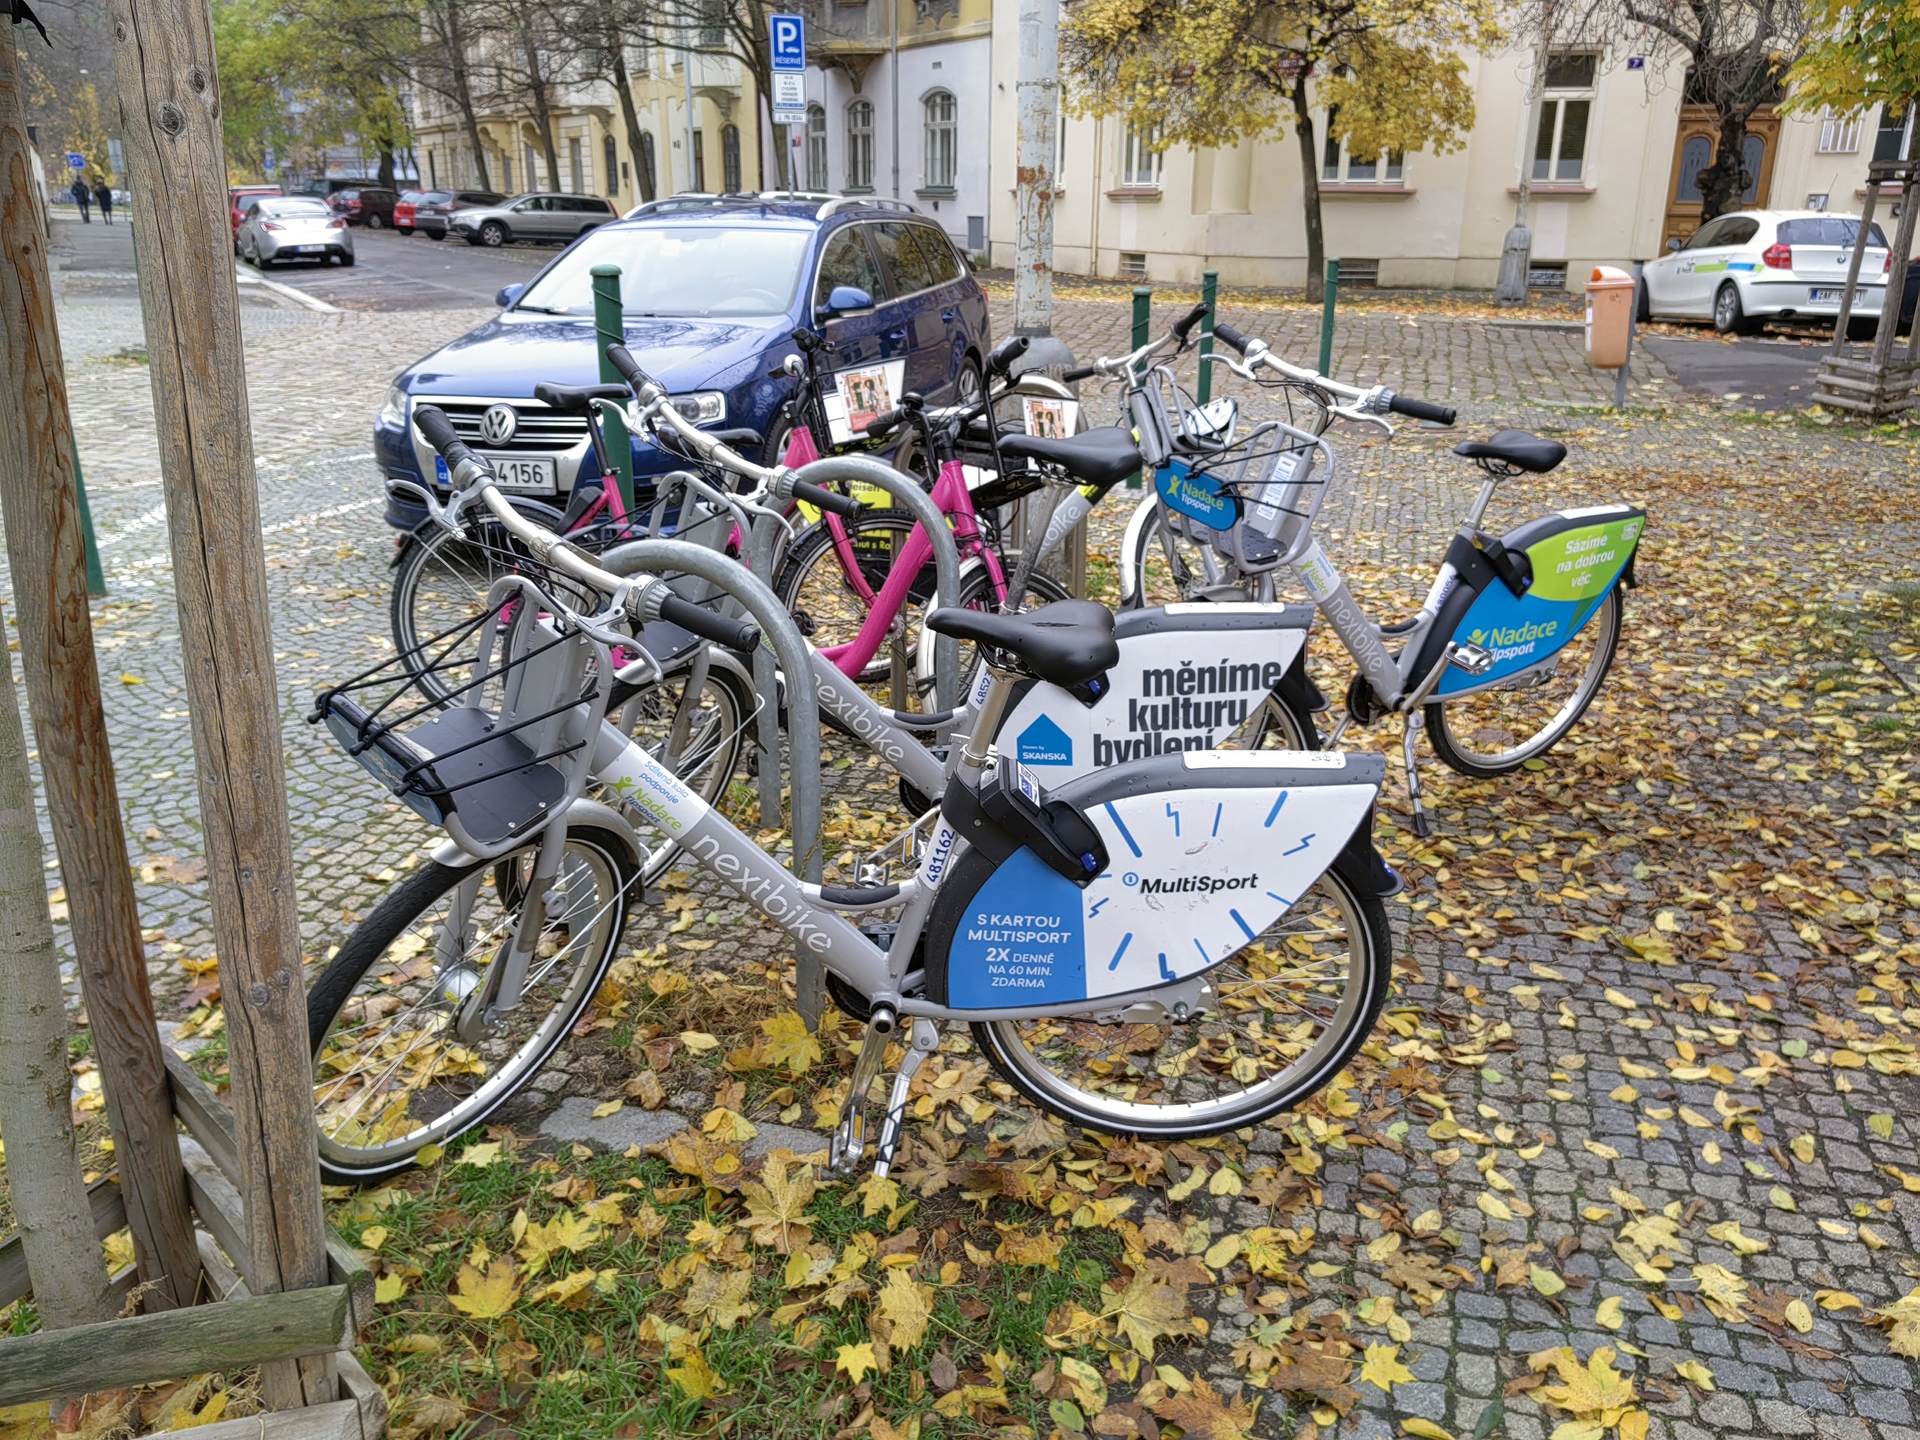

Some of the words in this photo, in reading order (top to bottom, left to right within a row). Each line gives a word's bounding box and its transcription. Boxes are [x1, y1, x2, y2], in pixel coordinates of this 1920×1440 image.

[777, 21, 797, 54] P
[1182, 481, 1225, 511] Nadace
[1182, 493, 1212, 514] Tipsport
[1564, 534, 1608, 555] Sázíme
[1555, 560, 1573, 574] na
[1574, 549, 1615, 570] dobrou
[1571, 571, 1592, 588] věc
[1327, 596, 1383, 673] nextbike
[1488, 620, 1558, 649] Nadace
[1142, 658, 1282, 698] měníme
[1128, 696, 1248, 732] kulturu
[1022, 751, 1068, 760] SKANSKA
[638, 772, 680, 805] podporuje
[625, 794, 661, 823] Tipsport
[631, 787, 683, 831] Nadace
[926, 828, 956, 883] 481162
[692, 834, 832, 953] nextbike
[1140, 873, 1259, 895] MultiSport
[976, 913, 988, 926] S
[990, 914, 1061, 928] KARTOU
[967, 929, 1072, 944] MULTISPORT
[985, 947, 1011, 962] 2X
[1012, 952, 1055, 964] DENNĚ
[988, 965, 1006, 974] NA
[1008, 965, 1024, 975] 60
[1026, 966, 1053, 976] MIN.
[991, 977, 1046, 988] ZDARMA
